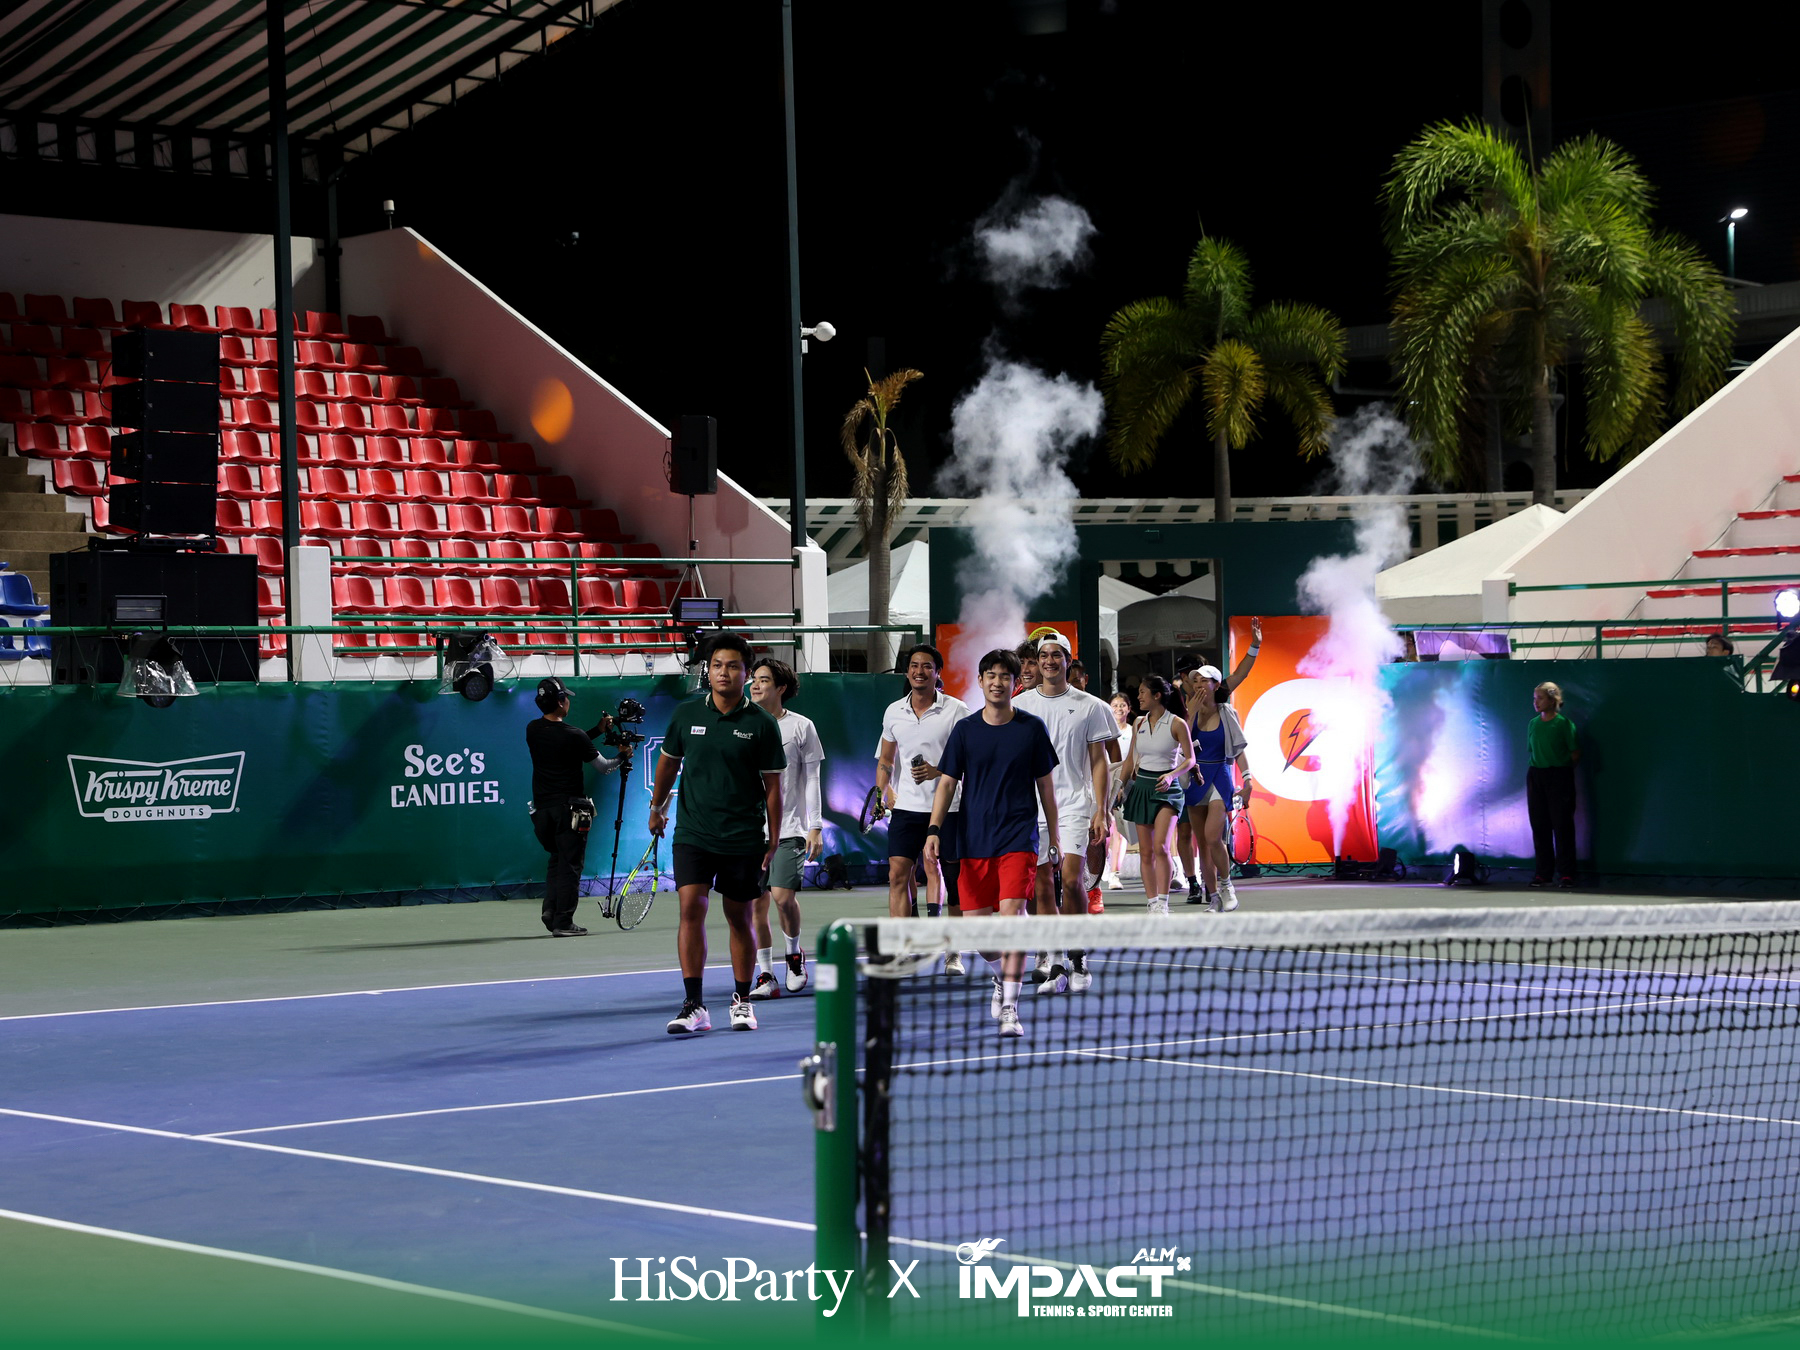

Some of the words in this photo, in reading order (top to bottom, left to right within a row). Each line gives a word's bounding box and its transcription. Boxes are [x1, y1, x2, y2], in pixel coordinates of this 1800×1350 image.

[404, 744, 485, 777] See's
[84, 769, 163, 805] Krispy
[160, 767, 235, 800] Kreme
[391, 781, 500, 808] CANDIES
[112, 808, 204, 819] DOUGHNUTS
